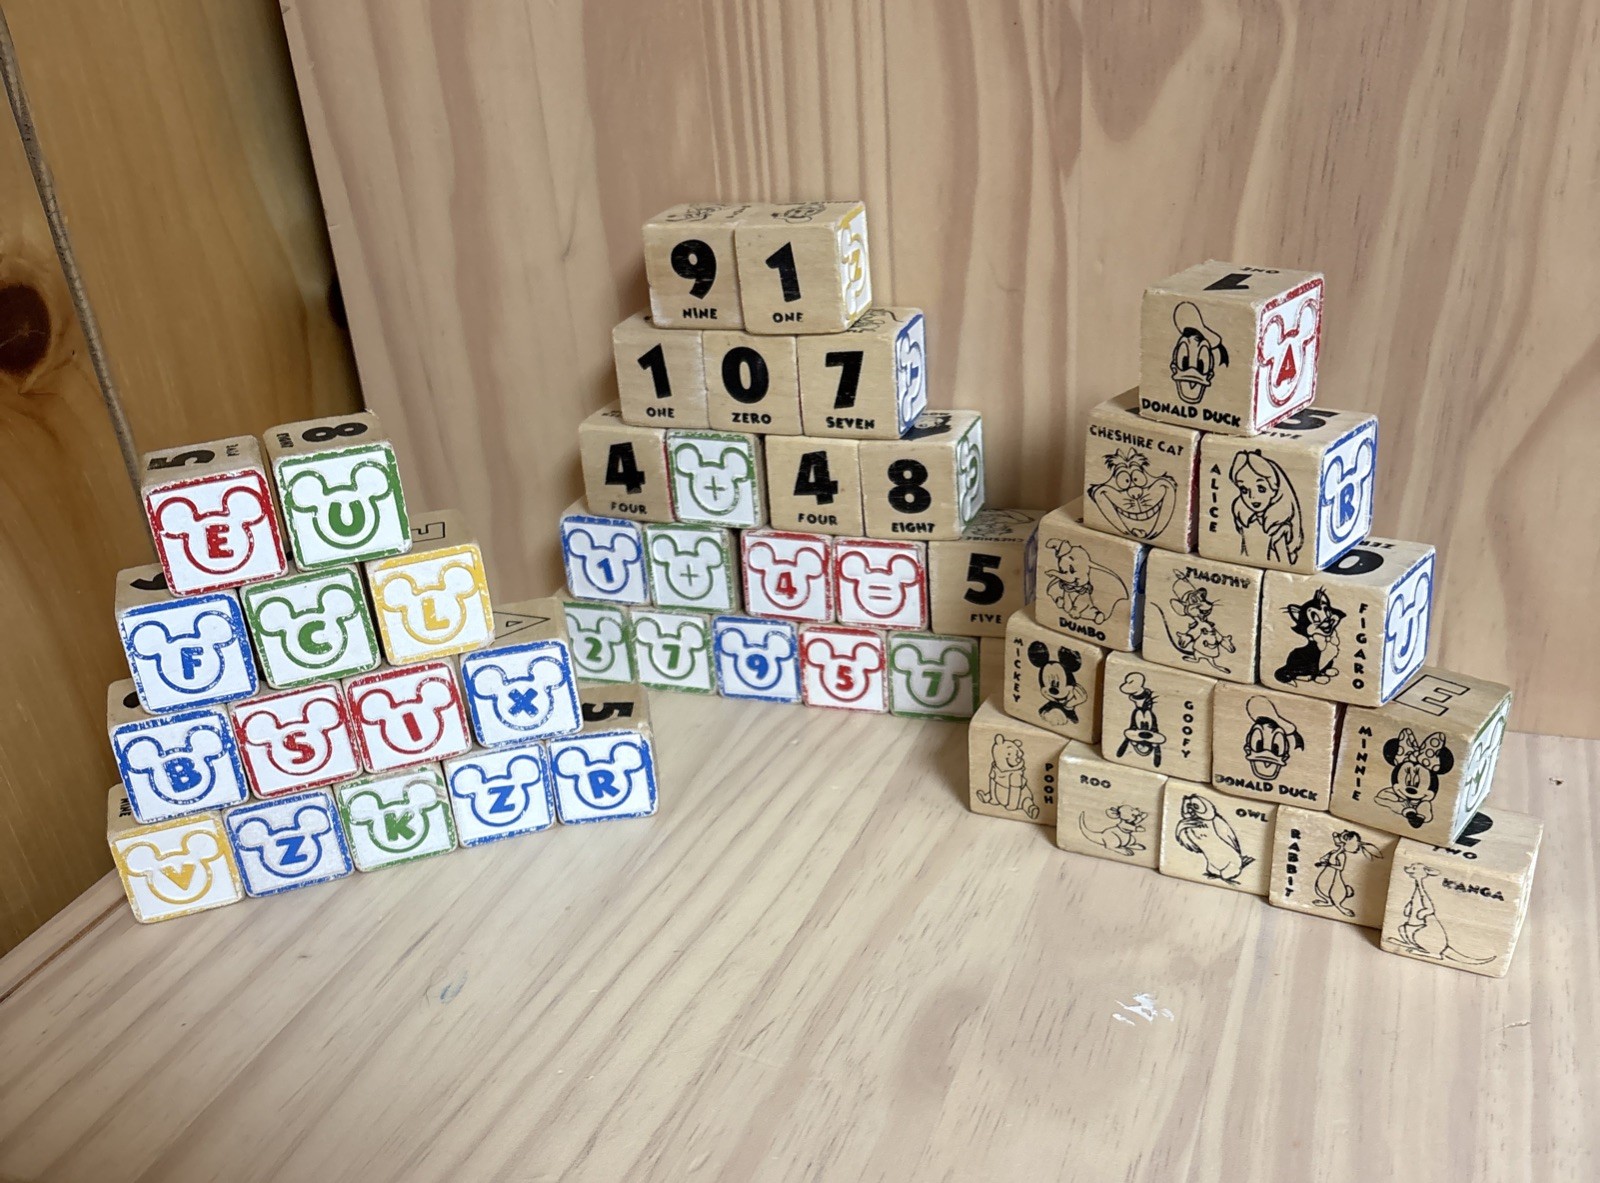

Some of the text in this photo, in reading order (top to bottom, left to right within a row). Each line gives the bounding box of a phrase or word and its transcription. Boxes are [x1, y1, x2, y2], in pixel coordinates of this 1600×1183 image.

[671, 239, 717, 300] 9
[765, 241, 802, 303] 1
[683, 307, 718, 320] NINE
[772, 311, 804, 323] ONE
[637, 343, 672, 399] 1
[722, 346, 769, 404] 0
[825, 351, 864, 410] 7
[1276, 343, 1297, 388] A
[646, 406, 675, 418] ONE
[731, 412, 772, 425] ZERO
[826, 417, 875, 430] SEVEN
[1141, 398, 1198, 419] DONALD
[1203, 409, 1242, 428] DUCK
[302, 422, 368, 443] 8
[1089, 425, 1185, 457] CHESHIRE CAT
[147, 449, 216, 471] 5
[605, 442, 646, 495] 4
[793, 450, 839, 505] 4
[887, 458, 932, 514] 8
[610, 501, 648, 515] FOUR
[1208, 463, 1222, 533] ALICE
[1338, 484, 1356, 528] R
[328, 499, 366, 537] U
[797, 513, 838, 526] FOUR
[891, 522, 936, 534] EIGHT
[205, 524, 234, 559] E
[1358, 540, 1396, 549] ZER
[597, 558, 615, 583] 1
[775, 571, 798, 600] 4
[964, 552, 1005, 605] 5
[1185, 566, 1252, 589] TIMOTHY
[422, 598, 450, 631] L
[970, 613, 1002, 625] FIVE
[1059, 617, 1107, 641] DUMBO
[299, 620, 333, 654] C
[585, 637, 602, 662] 2
[1351, 602, 1369, 690] FIGARO
[180, 647, 204, 680] F
[662, 644, 681, 670] 7
[746, 653, 769, 680] 9
[1012, 637, 1024, 703] MICKEY
[835, 665, 855, 692] 5
[921, 671, 943, 698] 7
[507, 687, 539, 718] X
[582, 702, 634, 722] 5
[1181, 700, 1195, 759] GOOFY
[283, 731, 316, 765] S
[1351, 725, 1373, 801] MINNIE
[164, 757, 203, 793] B
[588, 769, 621, 799] R
[1044, 763, 1055, 804] POOH
[1080, 774, 1112, 789] ROO
[1214, 772, 1319, 801] DONALD DUCK
[489, 785, 516, 814] Z
[385, 811, 415, 842] K
[1235, 807, 1270, 823] OWL
[276, 836, 308, 866] Z
[1285, 828, 1302, 897] RABBIT
[162, 863, 197, 891] V
[1441, 878, 1505, 901] KANGA
